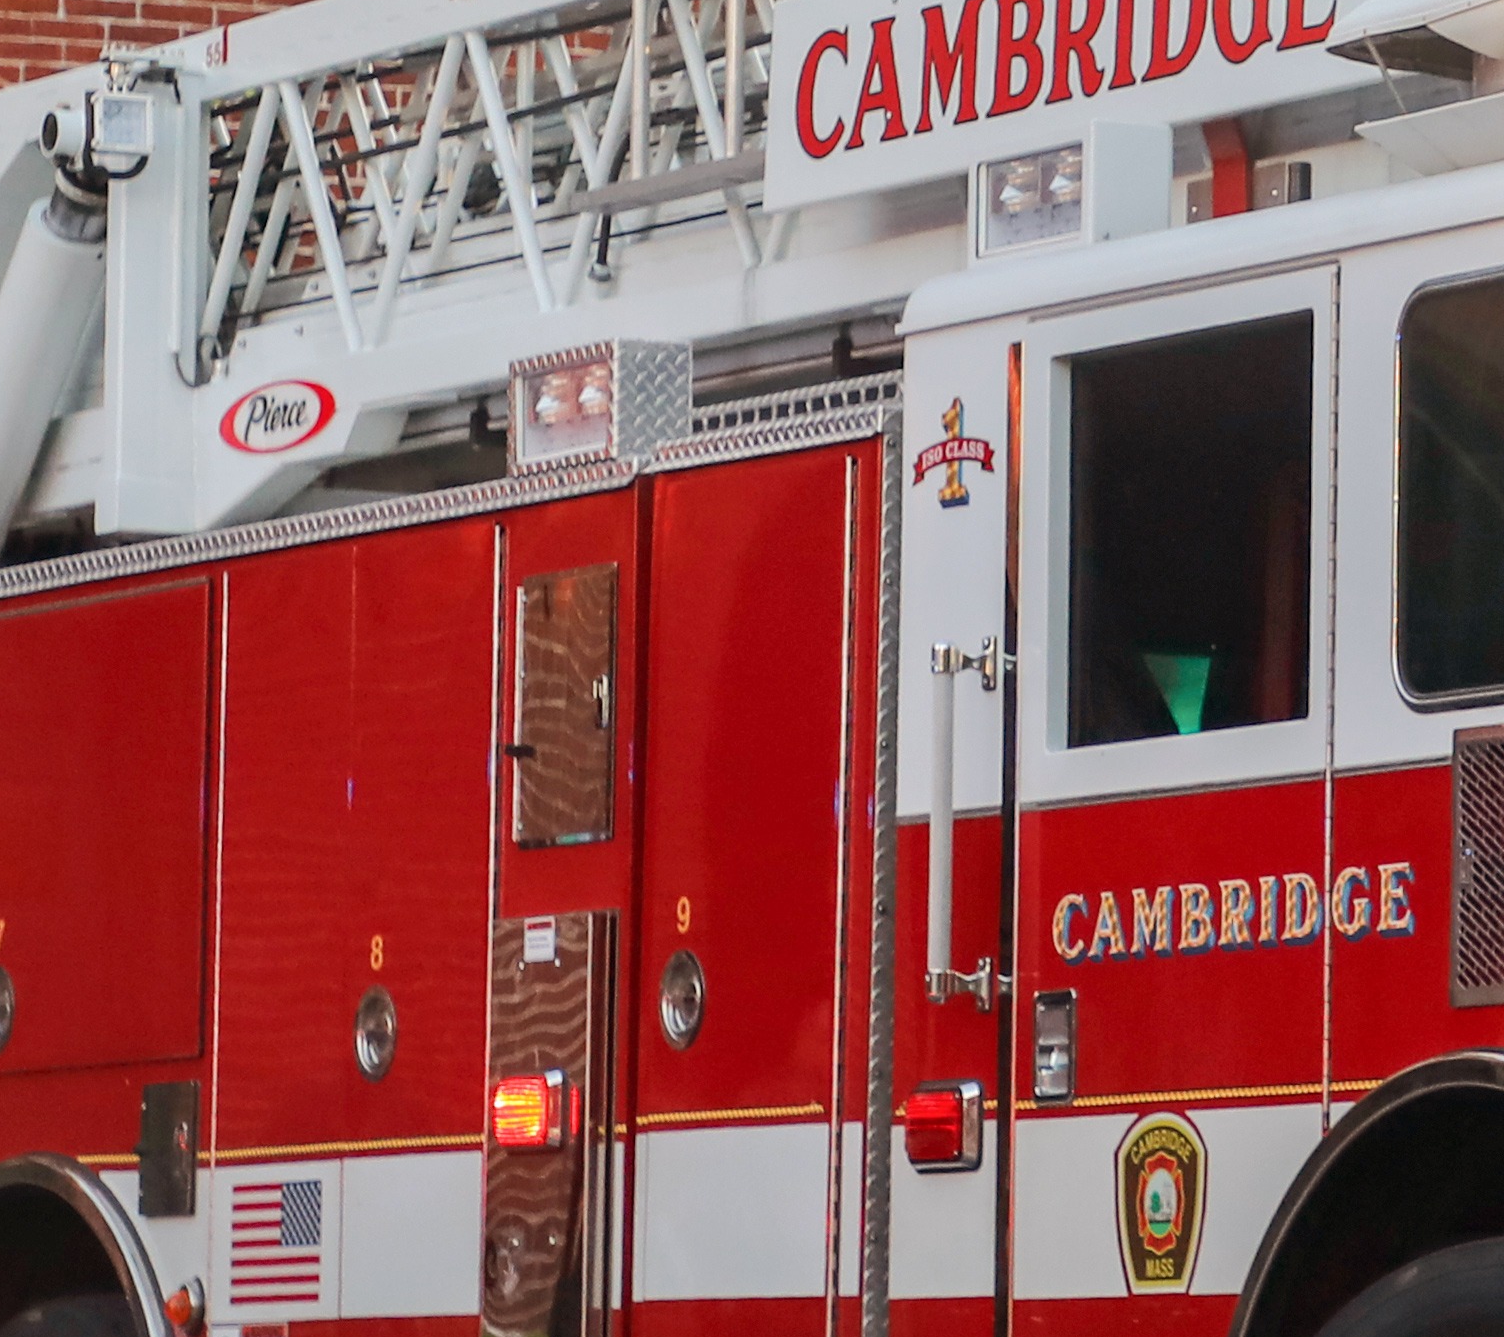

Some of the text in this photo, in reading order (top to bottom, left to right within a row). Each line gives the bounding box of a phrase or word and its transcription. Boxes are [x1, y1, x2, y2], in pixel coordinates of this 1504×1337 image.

[244, 394, 307, 445] Pierce
[921, 439, 985, 471] ISO CLASS
[677, 895, 691, 934] 9
[1051, 862, 1416, 965] CAMBRIDGE
[370, 934, 384, 971] 8
[1130, 1129, 1193, 1165] CAMBRIDGE
[1146, 1258, 1175, 1279] MASS
